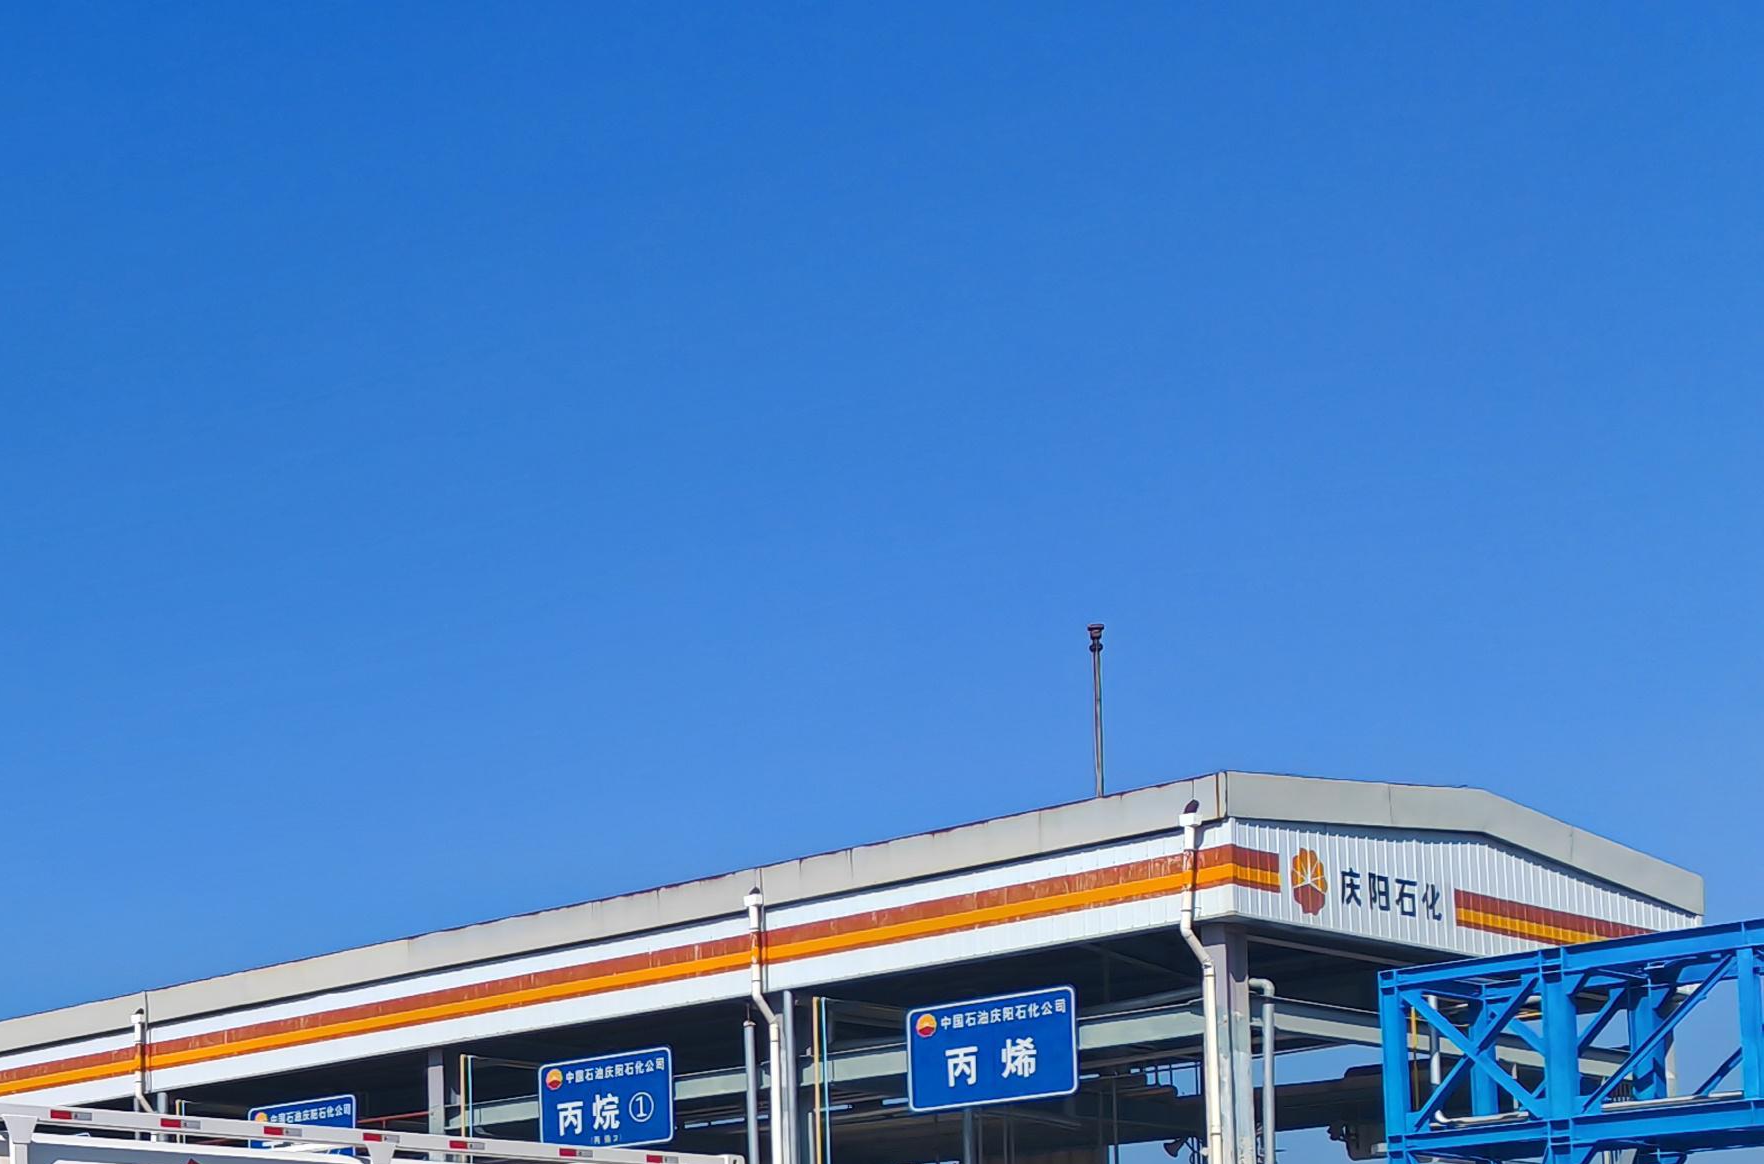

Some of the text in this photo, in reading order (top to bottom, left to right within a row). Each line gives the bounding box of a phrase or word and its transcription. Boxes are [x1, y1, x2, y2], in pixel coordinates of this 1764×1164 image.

[1340, 868, 1442, 922] 庆阳石化
[940, 998, 1066, 1030] 中国石油庆阳石化公司
[566, 1057, 665, 1084] 中国石油庆阳石化公司
[945, 1037, 1037, 1088] 丙烯
[270, 1103, 351, 1123] 中国石油庆阳石化公司
